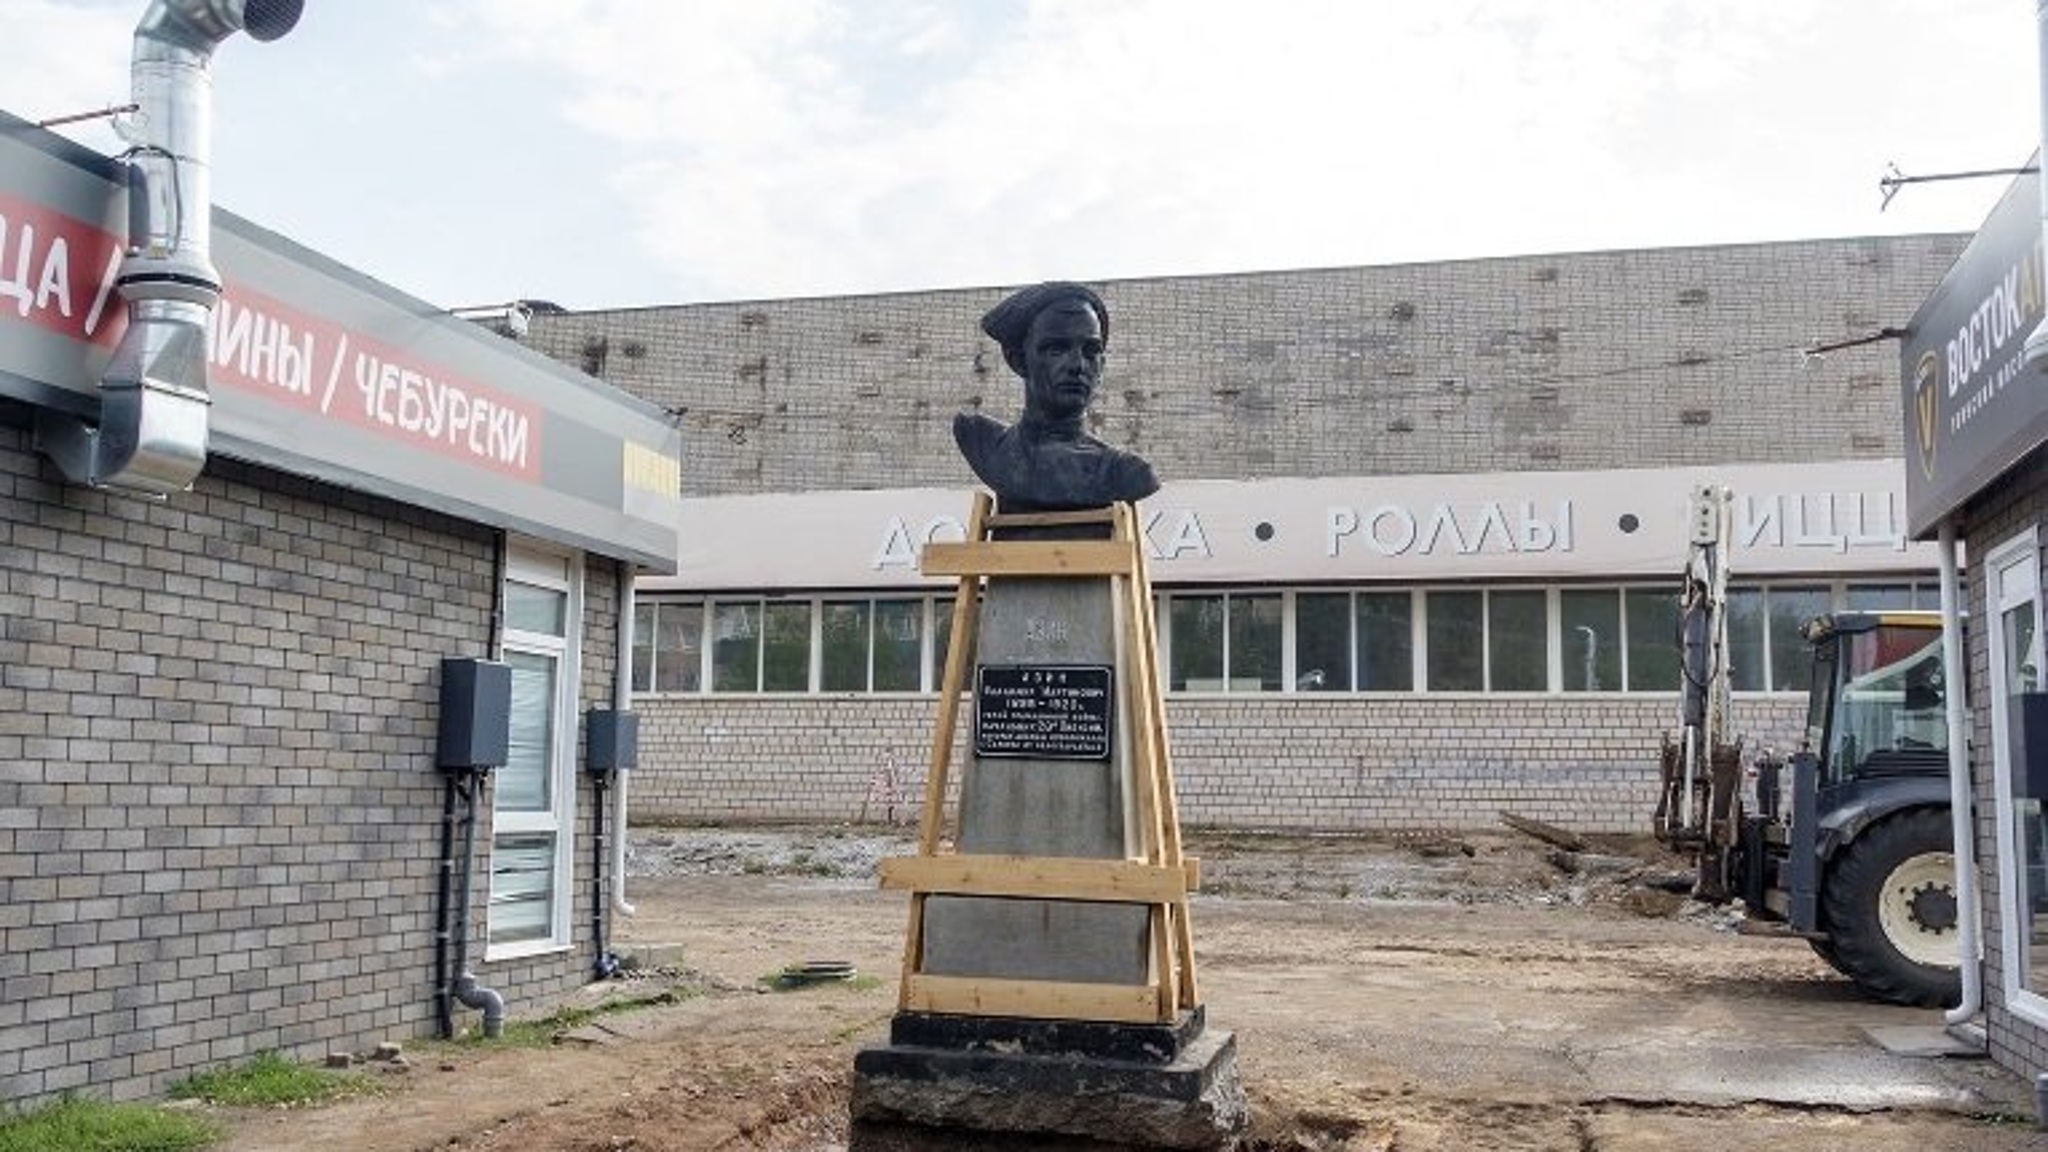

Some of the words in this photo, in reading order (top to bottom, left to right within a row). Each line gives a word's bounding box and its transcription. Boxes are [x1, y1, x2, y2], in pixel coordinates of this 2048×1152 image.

[206, 299, 314, 395] ИНЫ
[355, 352, 528, 469] ЧЕБУРЕКИ
[1328, 499, 1575, 557] РОЛЛЫ
[1738, 492, 1907, 554] ИЦЦ
